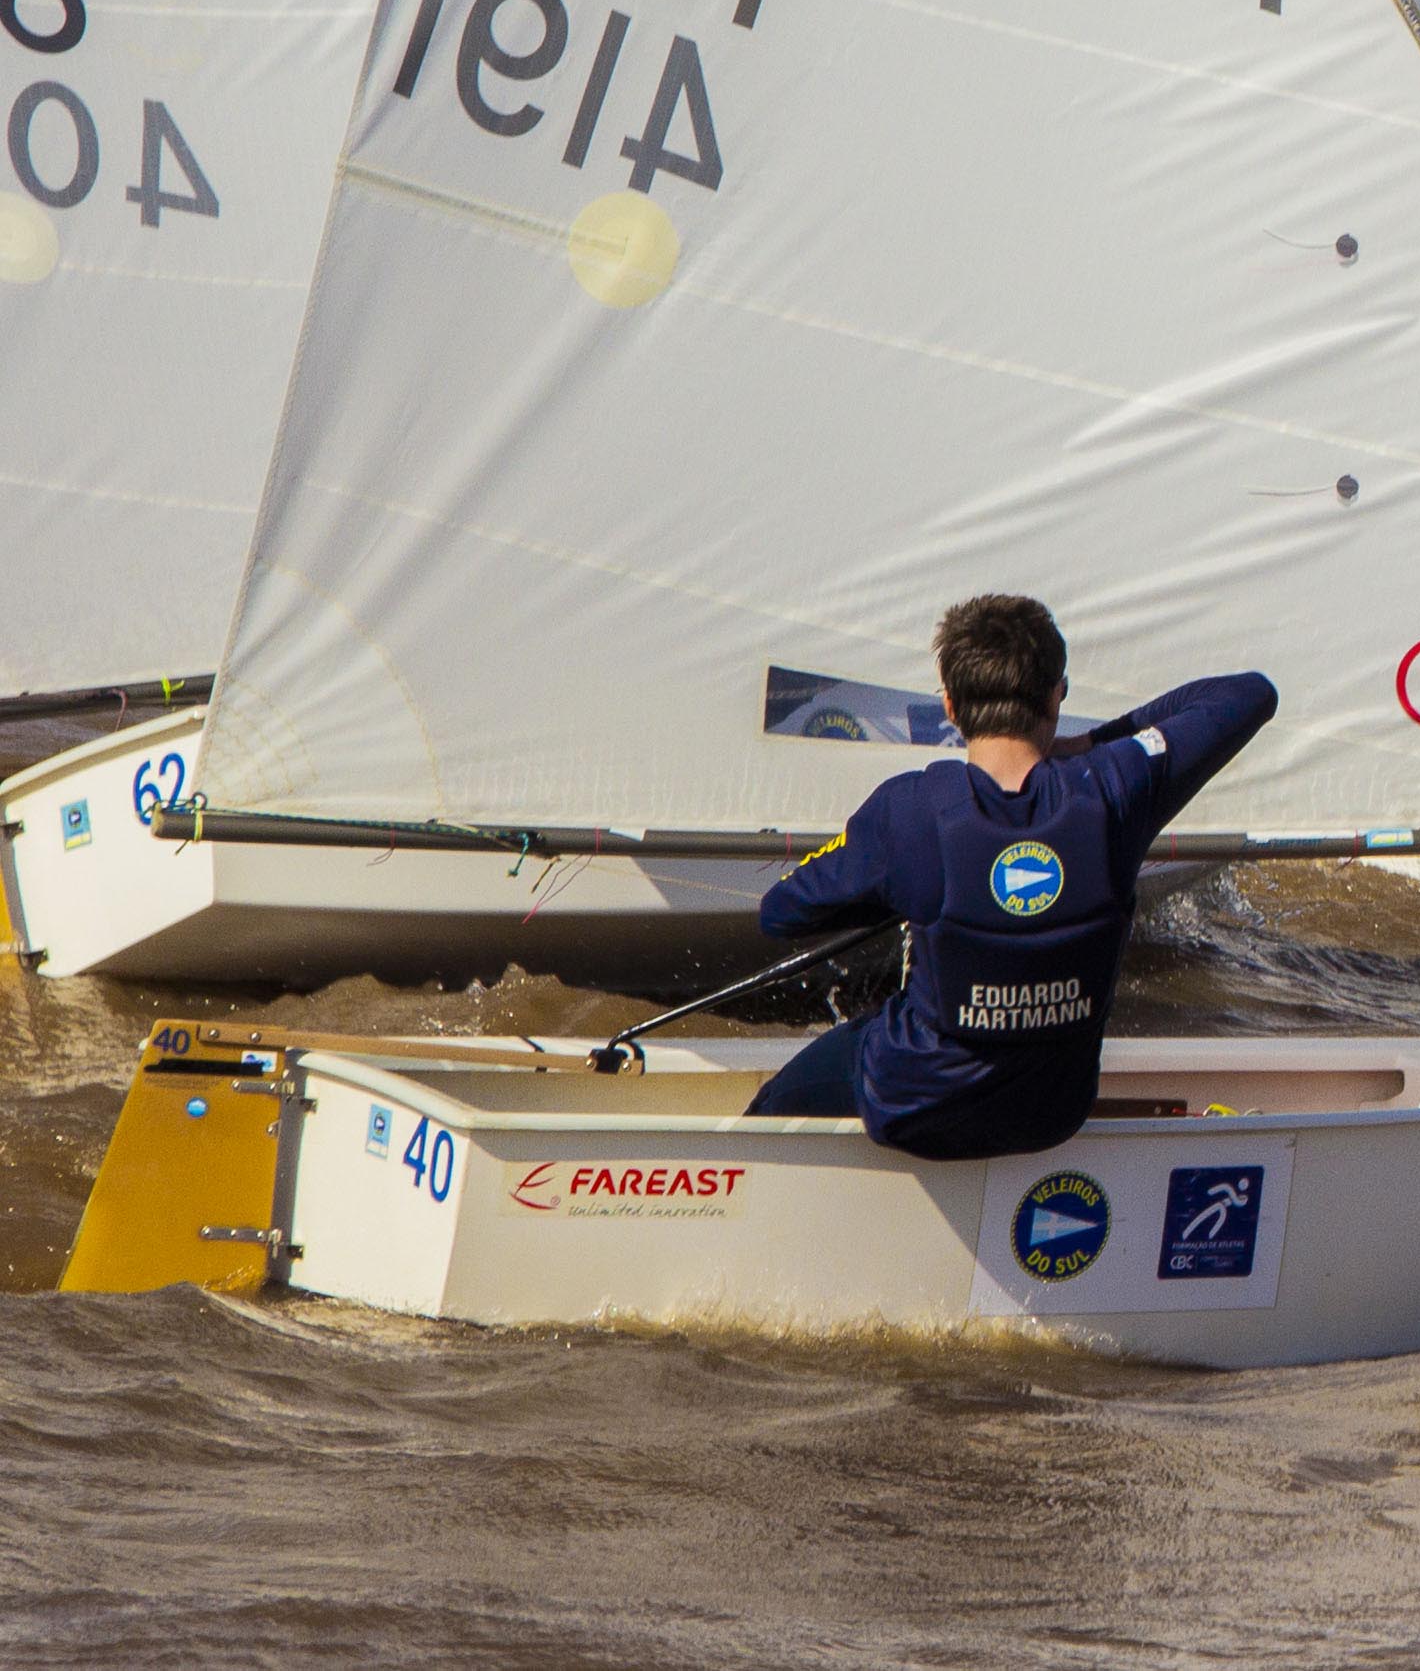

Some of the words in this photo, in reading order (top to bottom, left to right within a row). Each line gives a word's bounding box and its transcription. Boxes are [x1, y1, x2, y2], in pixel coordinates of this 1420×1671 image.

[133, 752, 188, 826] 62
[1001, 846, 1052, 866] VELEIROS
[1006, 893, 1025, 910] DO
[1027, 891, 1054, 911] SUL
[971, 978, 1080, 1008] EDUARDO
[958, 996, 1092, 1031] HARTMANN
[153, 1026, 191, 1055] 40
[403, 1116, 456, 1203] 40
[569, 1168, 746, 1196] FAREAST
[1031, 1178, 1100, 1208] VELEIROS
[649, 1205, 726, 1218] innovation
[1026, 1249, 1050, 1273] DO
[1055, 1248, 1091, 1276] SUL
